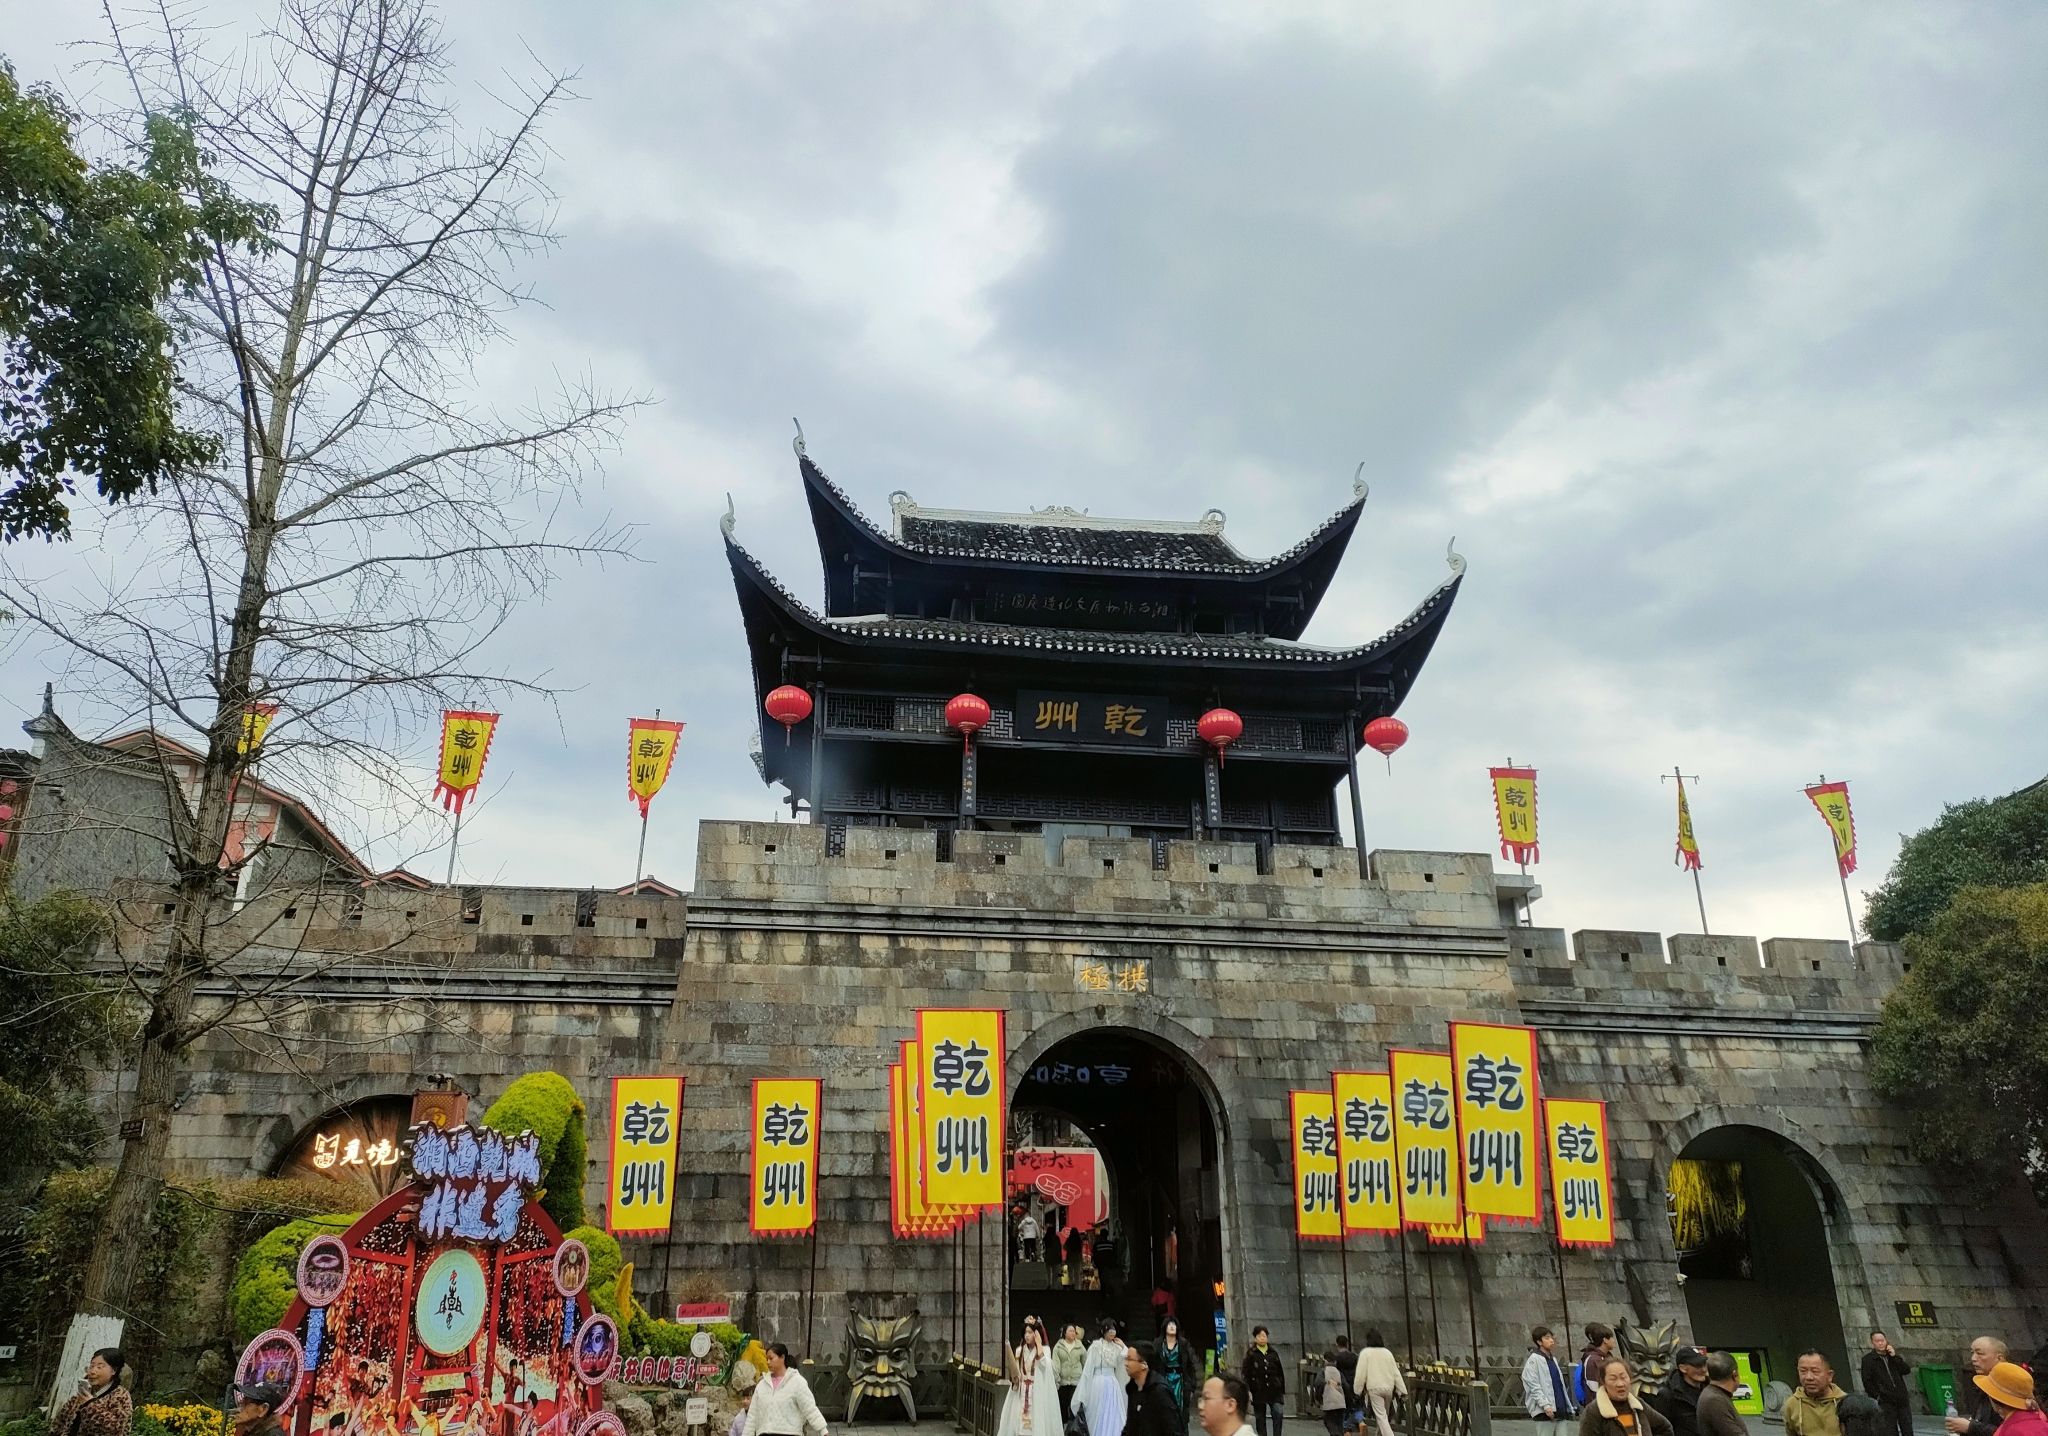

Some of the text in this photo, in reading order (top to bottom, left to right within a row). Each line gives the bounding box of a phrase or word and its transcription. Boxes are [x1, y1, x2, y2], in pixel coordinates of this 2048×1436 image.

[452, 728, 479, 776] 乾州
[636, 738, 665, 783] 乾州
[1035, 700, 1148, 736] 乾州
[1505, 786, 1527, 831] 乾州
[621, 1101, 670, 1206] 乾州
[763, 1102, 810, 1206] 乾州
[933, 1040, 990, 1173] 乾州
[1345, 1097, 1390, 1204] 乾州
[1403, 1079, 1450, 1197] 乾州
[1465, 1054, 1524, 1187] 乾州
[1302, 1115, 1339, 1213] 乾州
[1557, 1122, 1604, 1220] 乾州
